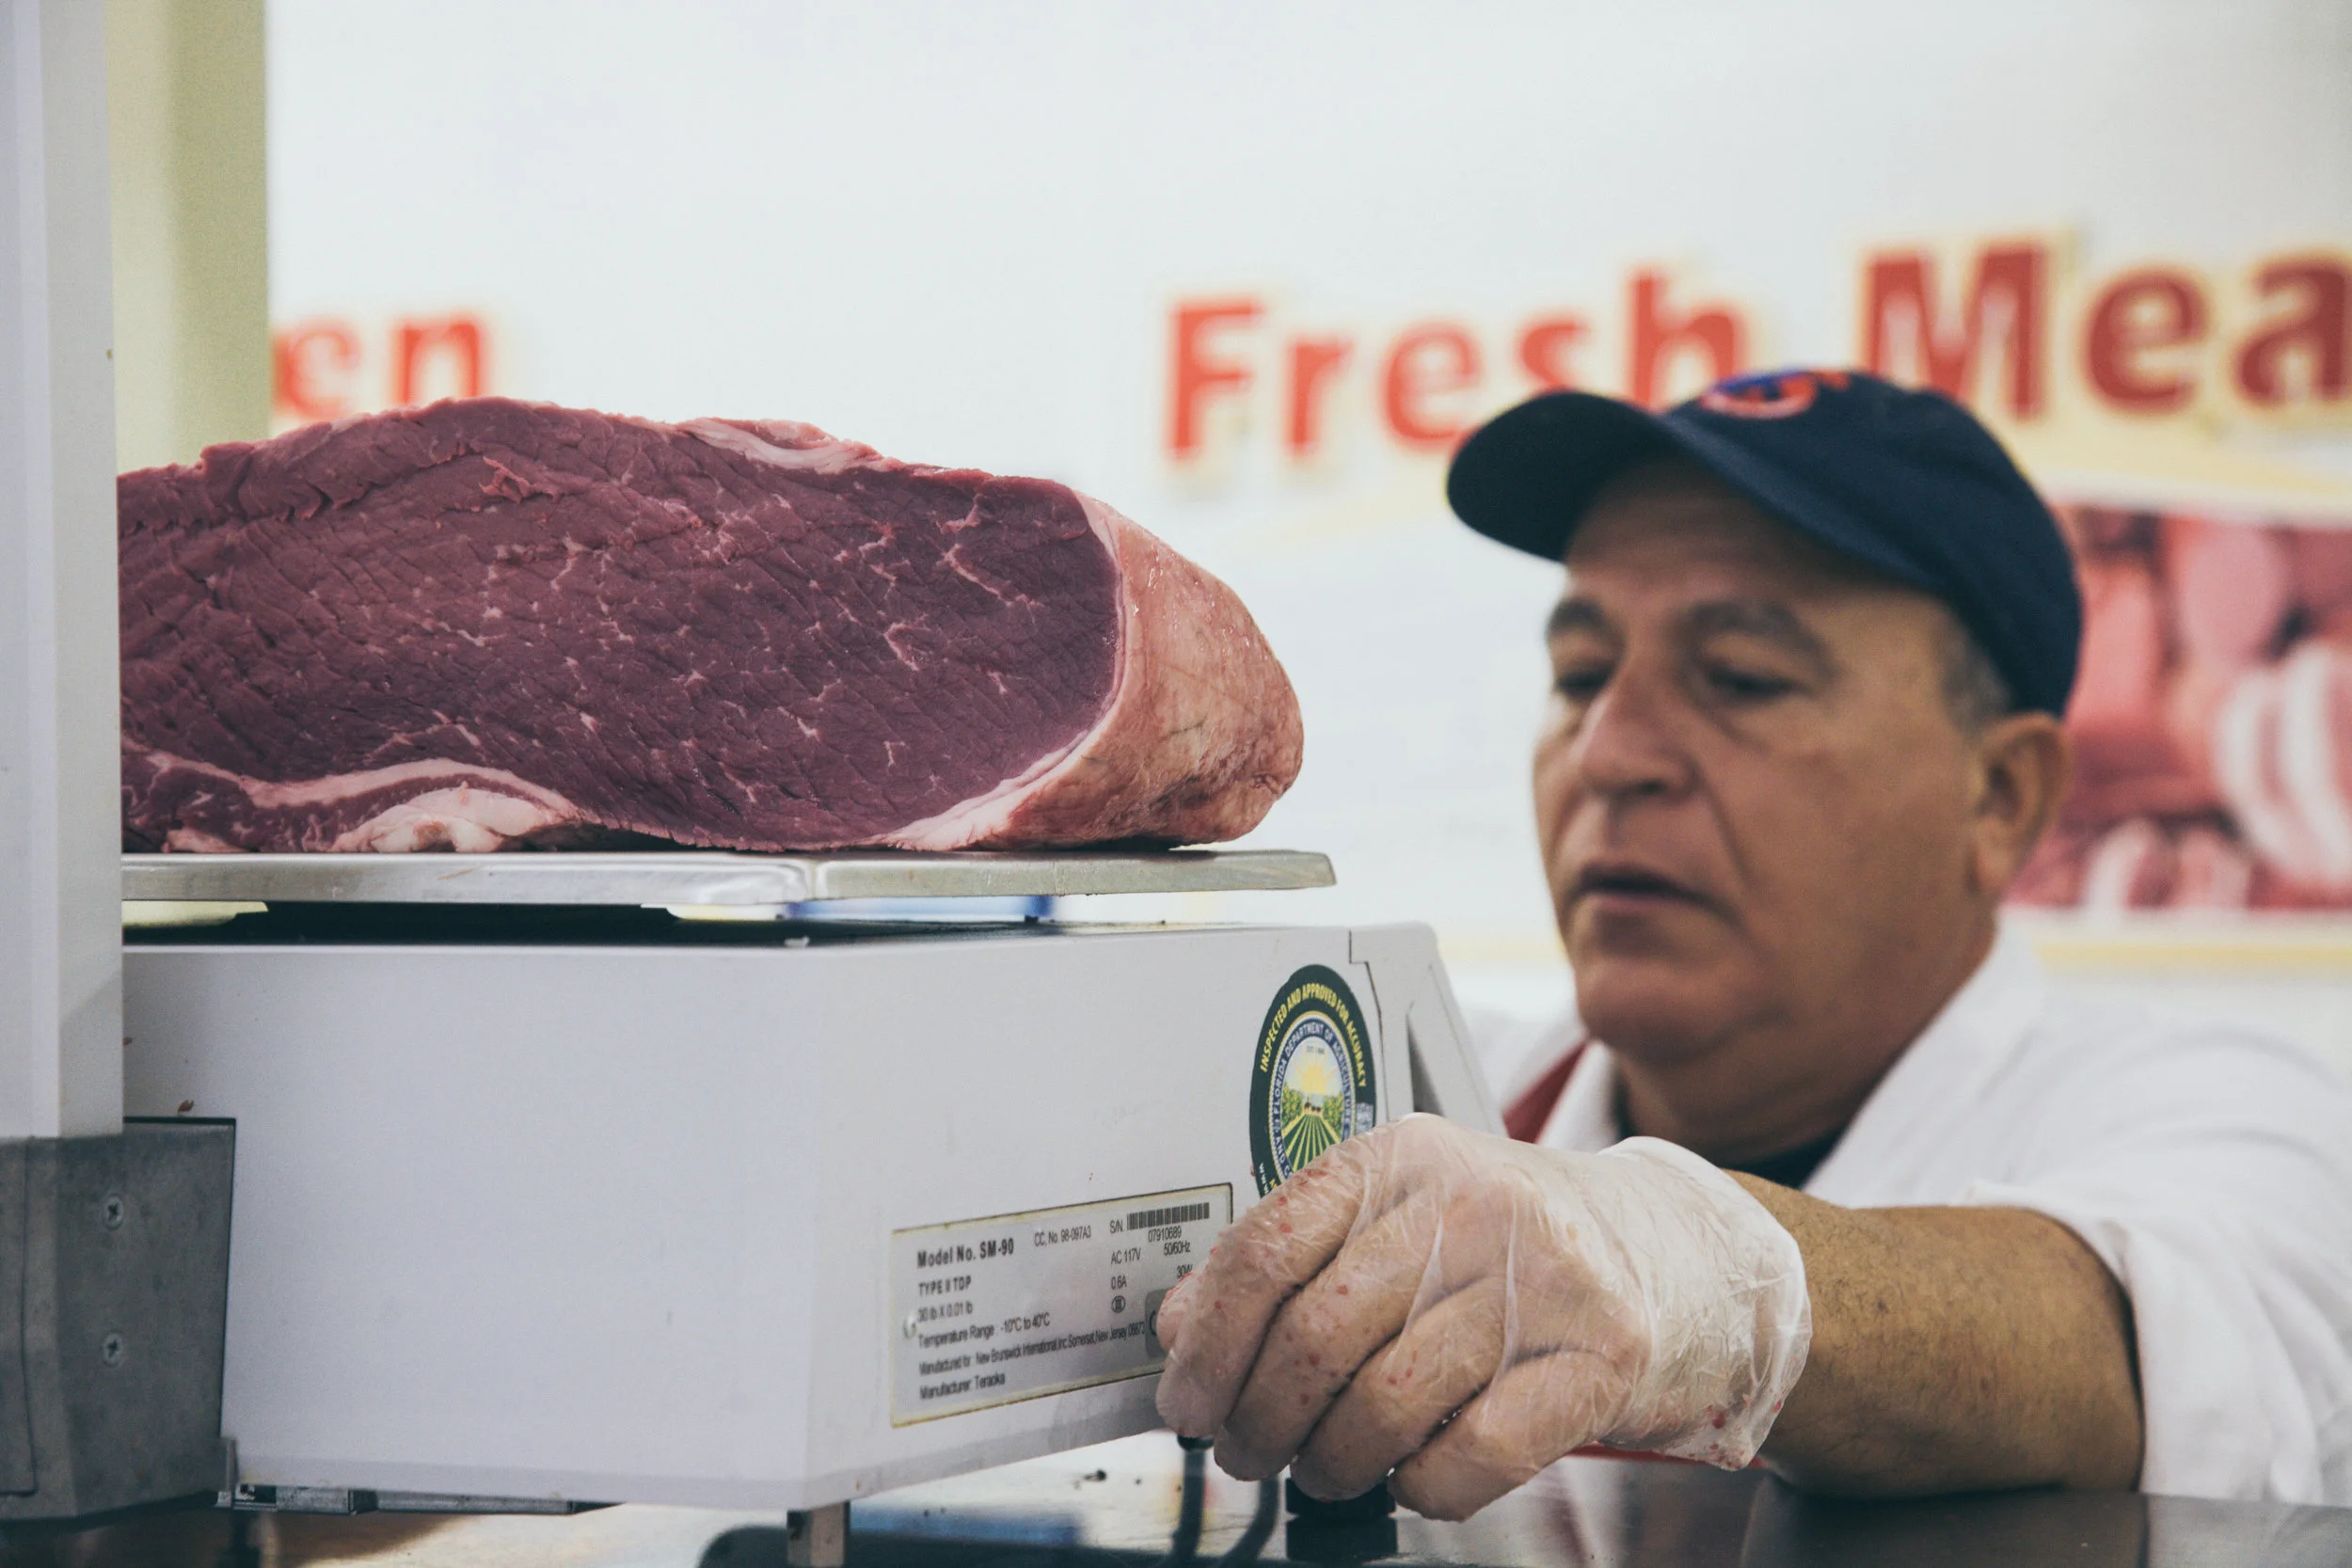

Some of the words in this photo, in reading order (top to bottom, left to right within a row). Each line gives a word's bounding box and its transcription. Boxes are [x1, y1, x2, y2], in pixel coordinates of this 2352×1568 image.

[1167, 265, 1747, 461] Fresh
[1260, 1003, 1288, 1072] INSPECTED
[1287, 988, 1302, 1012] AND
[1302, 982, 1337, 1009] APPROVED
[1335, 998, 1349, 1024] FOR
[1346, 1020, 1367, 1087] ACCURACY
[1273, 1057, 1288, 1114] FLORIDA
[1284, 1022, 1324, 1057] DEPARTMENT
[917, 1247, 953, 1269] Model
[957, 1244, 976, 1262] No.
[979, 1237, 1014, 1259] SM-90
[1111, 1249, 1122, 1265] AC
[1124, 1246, 1142, 1263] 117V
[1164, 1241, 1191, 1257] 50/60Hz
[918, 1279, 943, 1296] TYPE
[918, 1327, 969, 1349] Temperature
[1023, 1316, 1031, 1330] to
[991, 1345, 1022, 1363] Brunswick
